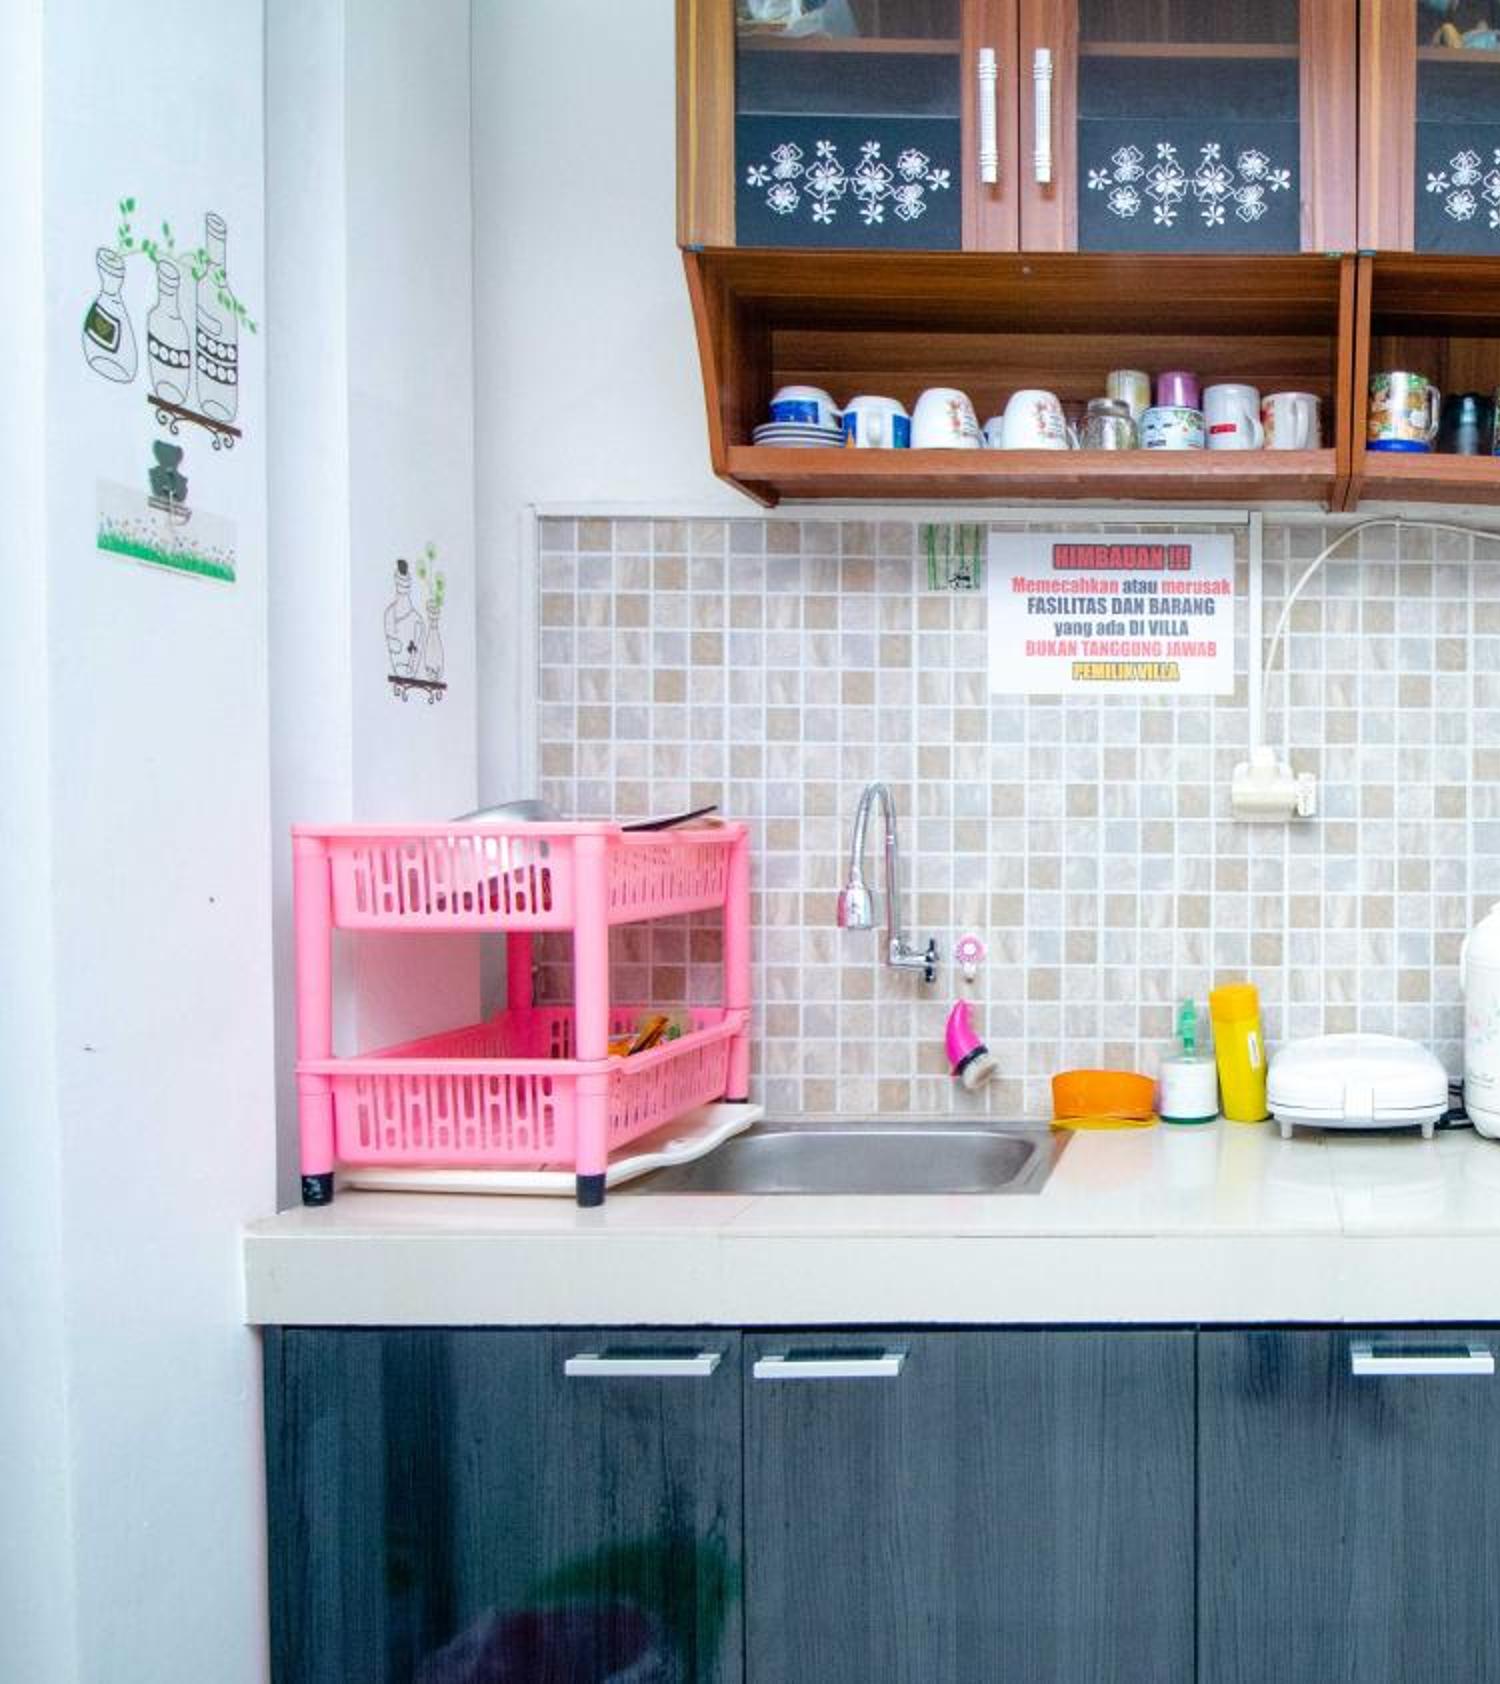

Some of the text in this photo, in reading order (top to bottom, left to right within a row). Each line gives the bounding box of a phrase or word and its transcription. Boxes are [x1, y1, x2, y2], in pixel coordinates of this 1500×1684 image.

[1053, 543, 1164, 570] HIMBAUAN
[1012, 577, 1231, 594] Memecahkan atau merusak
[1027, 597, 1215, 615] FASILITAS DAN BARANG
[1054, 619, 1189, 637] yang ada DI VILLA
[1025, 640, 1217, 657] BUKAN TANGGUNG JAWAB
[1072, 662, 1180, 681] PEMILIK VILLA
